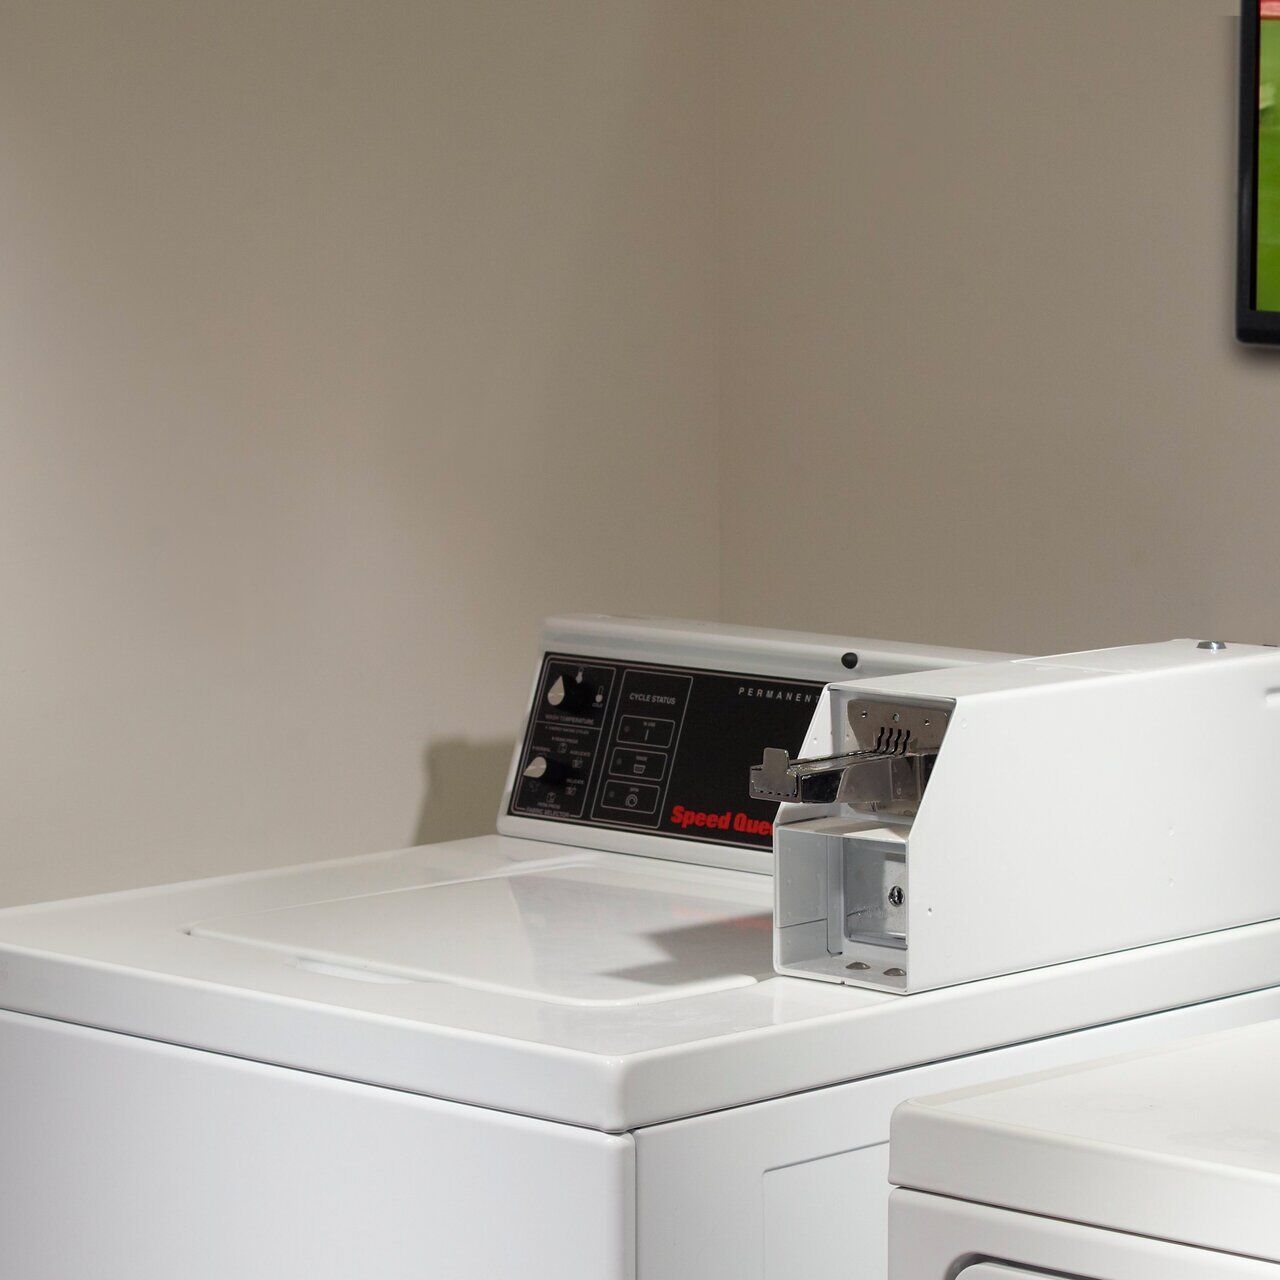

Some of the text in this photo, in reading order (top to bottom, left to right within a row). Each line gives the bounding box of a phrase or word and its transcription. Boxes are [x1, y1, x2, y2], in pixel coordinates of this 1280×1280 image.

[629, 692, 676, 705] CYCLE STATUS
[671, 805, 773, 836] Speed Que
